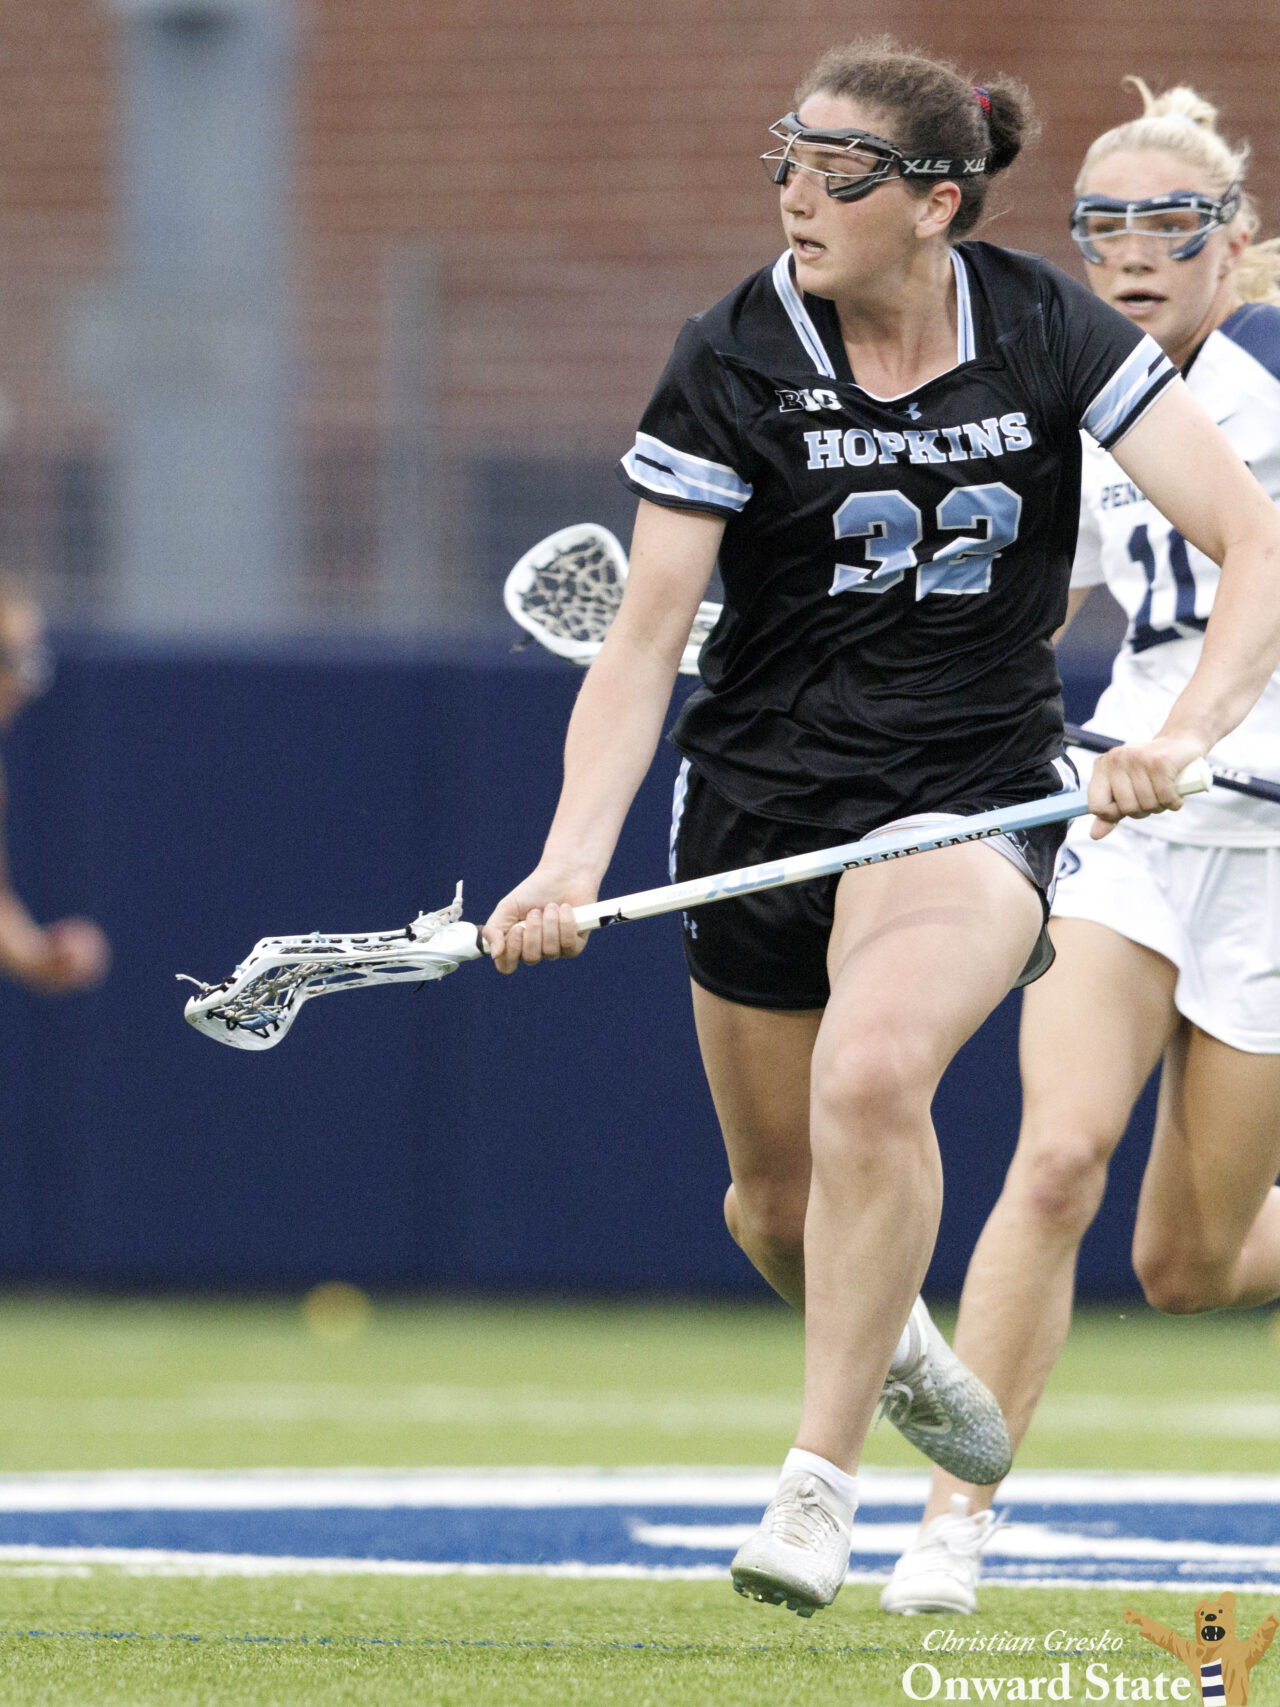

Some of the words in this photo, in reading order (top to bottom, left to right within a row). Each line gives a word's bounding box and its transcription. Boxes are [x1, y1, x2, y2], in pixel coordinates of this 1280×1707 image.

[902, 159, 953, 174] STX
[804, 412, 1034, 470] HOPKINS
[1101, 481, 1147, 511] PEN
[827, 481, 1023, 602] 32
